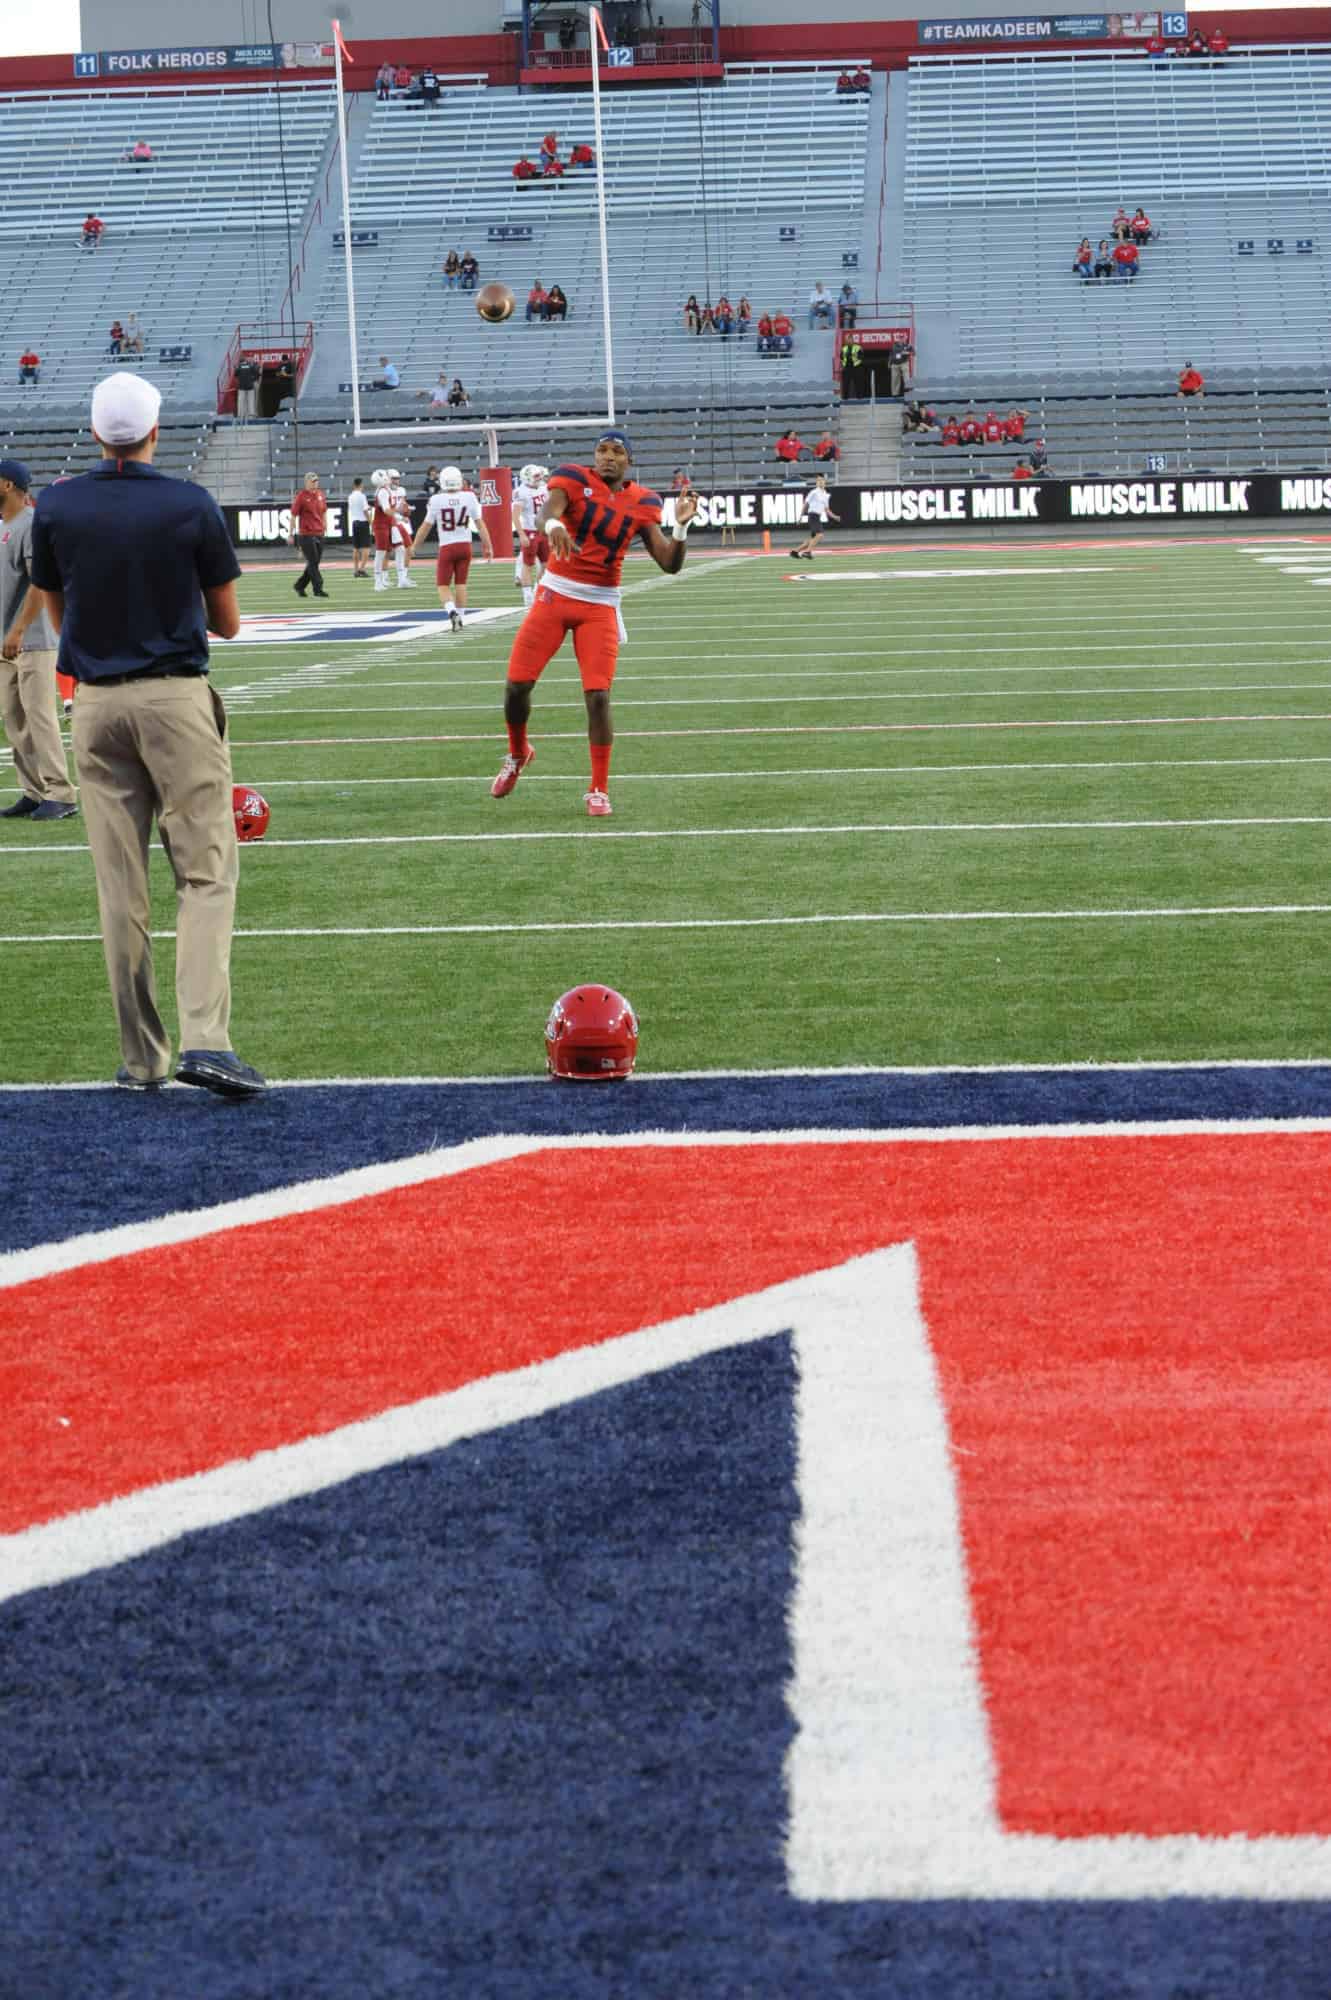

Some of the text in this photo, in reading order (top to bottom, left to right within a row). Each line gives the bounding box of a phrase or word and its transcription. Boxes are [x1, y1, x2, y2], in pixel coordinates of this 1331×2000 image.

[923, 21, 1051, 39] #TEAMKADEEM
[1164, 16, 1186, 33] 13
[78, 56, 95, 73] 11
[108, 55, 152, 71] FOLK
[158, 51, 227, 67] HEROES
[610, 49, 631, 65] 12
[1149, 456, 1165, 471] 13
[860, 487, 1038, 521] MUSCLE MILK
[1070, 481, 1249, 515] MUSCLE MILK
[441, 506, 470, 532] 94
[661, 494, 757, 528] MSCLE
[238, 508, 342, 541] MUSE
[575, 498, 634, 568] 14
